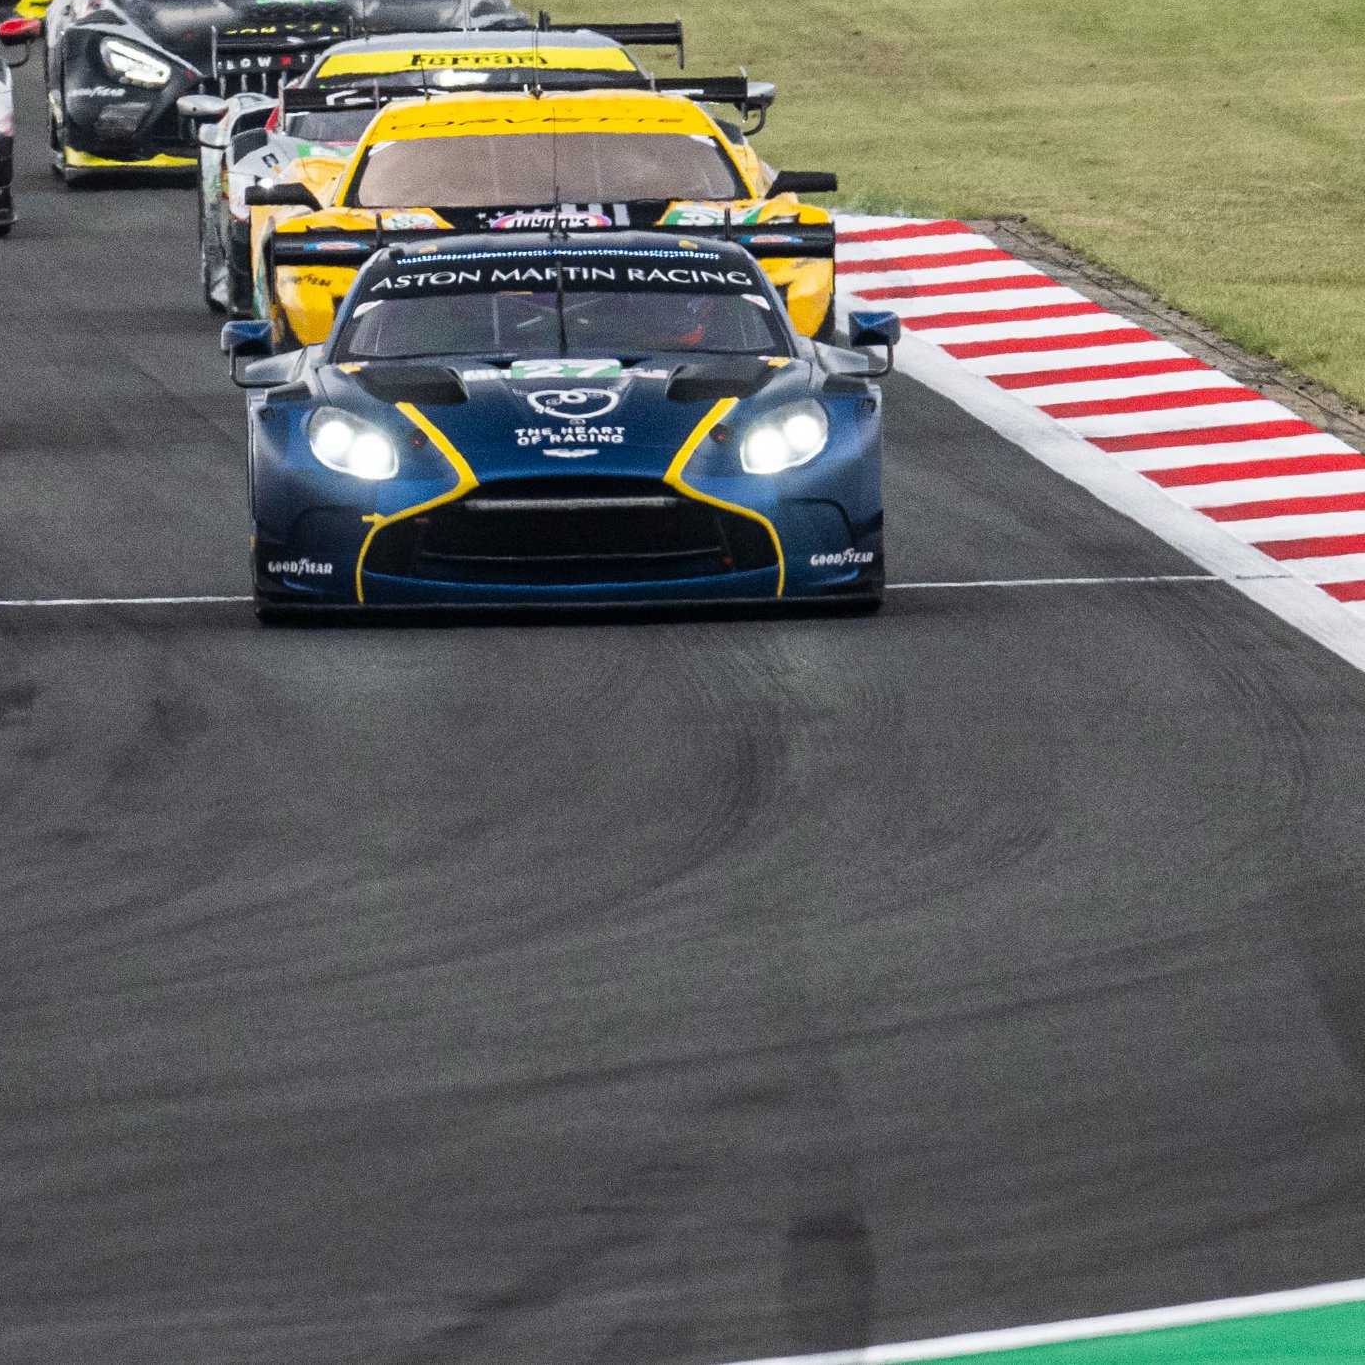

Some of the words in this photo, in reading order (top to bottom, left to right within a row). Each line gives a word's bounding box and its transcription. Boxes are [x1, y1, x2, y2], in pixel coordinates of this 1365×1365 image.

[409, 52, 549, 67] Ferrari
[370, 270, 481, 292] ASTON
[490, 266, 616, 283] MARTIN
[627, 266, 753, 286] RACING
[523, 363, 612, 378] 27
[514, 427, 553, 437] THE
[560, 426, 626, 436] HEART
[516, 435, 543, 446] OF
[549, 434, 624, 445] RACING
[810, 547, 874, 567] GOODYEAR
[267, 557, 333, 577] GOODYEAR
